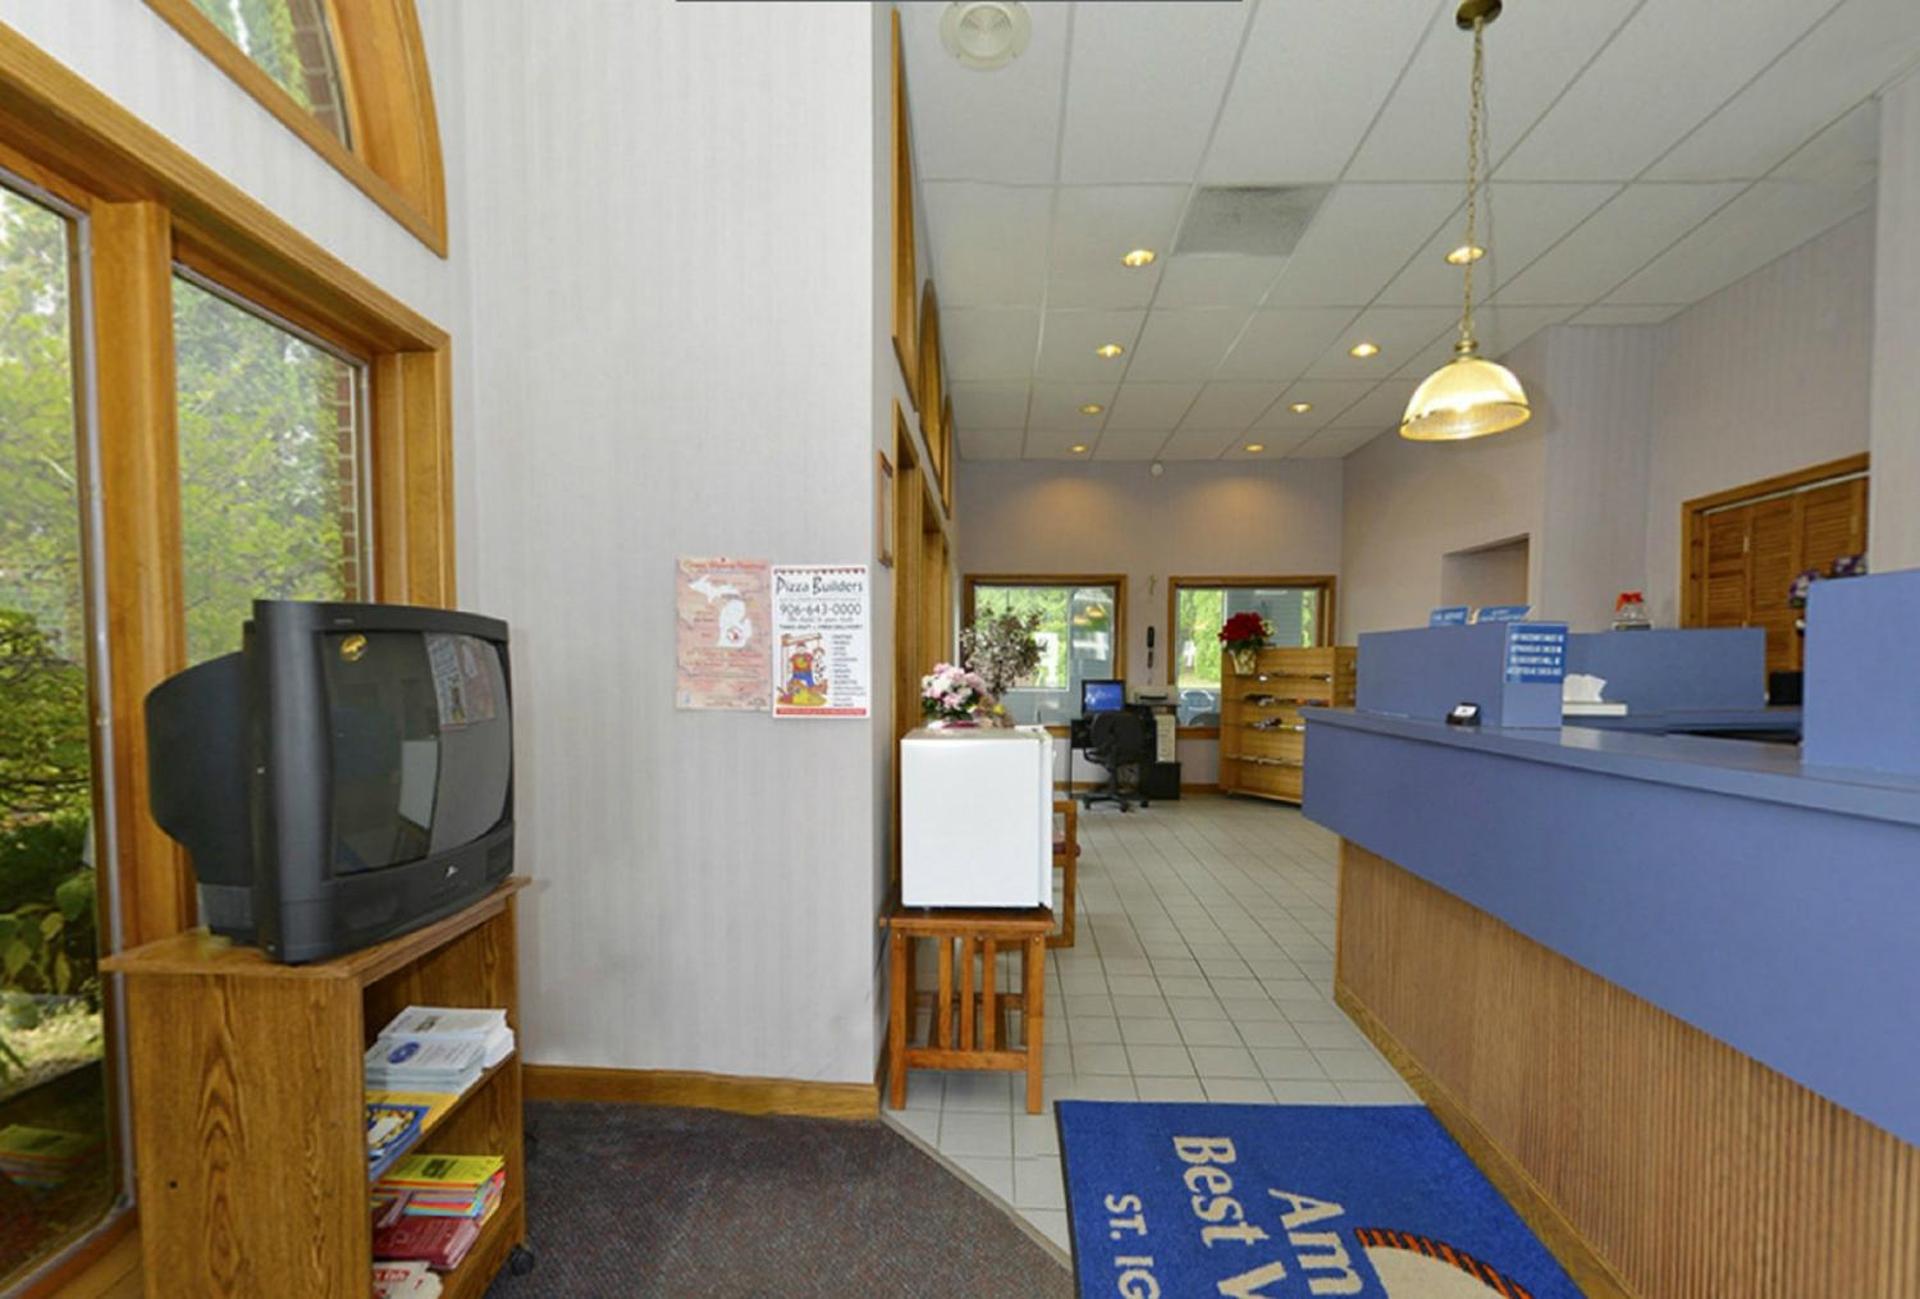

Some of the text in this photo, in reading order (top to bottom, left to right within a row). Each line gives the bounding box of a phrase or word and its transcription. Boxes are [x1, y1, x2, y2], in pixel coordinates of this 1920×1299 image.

[776, 576, 864, 595] Pizza Builders
[779, 603, 862, 615] 906-643-0000
[1173, 1137, 1270, 1248] Best
[1104, 1194, 1148, 1240] ST.
[1268, 1188, 1363, 1295] Am
